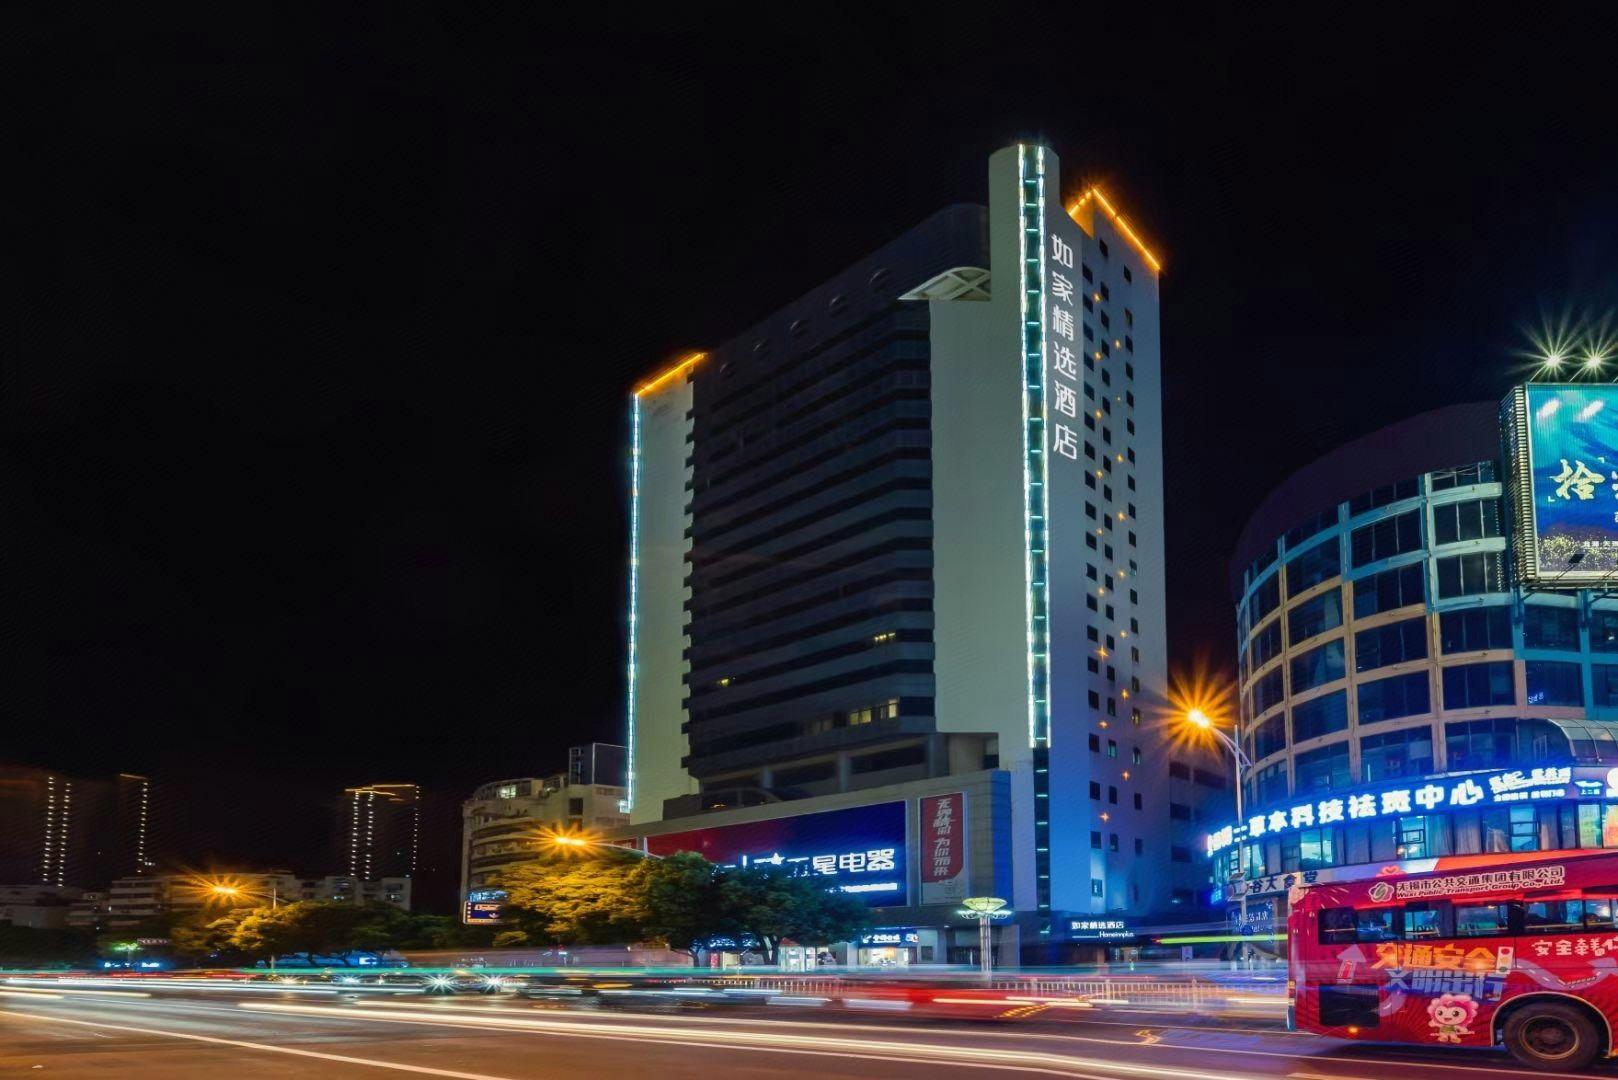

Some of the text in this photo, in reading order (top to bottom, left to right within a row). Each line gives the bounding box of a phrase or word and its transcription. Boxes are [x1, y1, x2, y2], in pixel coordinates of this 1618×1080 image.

[1051, 233, 1078, 460] 如家精选酒店
[786, 848, 895, 878] 星电器
[1397, 865, 1565, 892] 无锡市公共交通集团有限公司
[1397, 890, 1417, 898] Wuxi
[1418, 888, 1443, 897] Public
[1446, 884, 1490, 894] Transport
[1491, 881, 1519, 891] Group
[1543, 877, 1565, 887] Ltd.
[1371, 943, 1497, 973] 交通安全
[1384, 967, 1506, 1002] 文明出行
